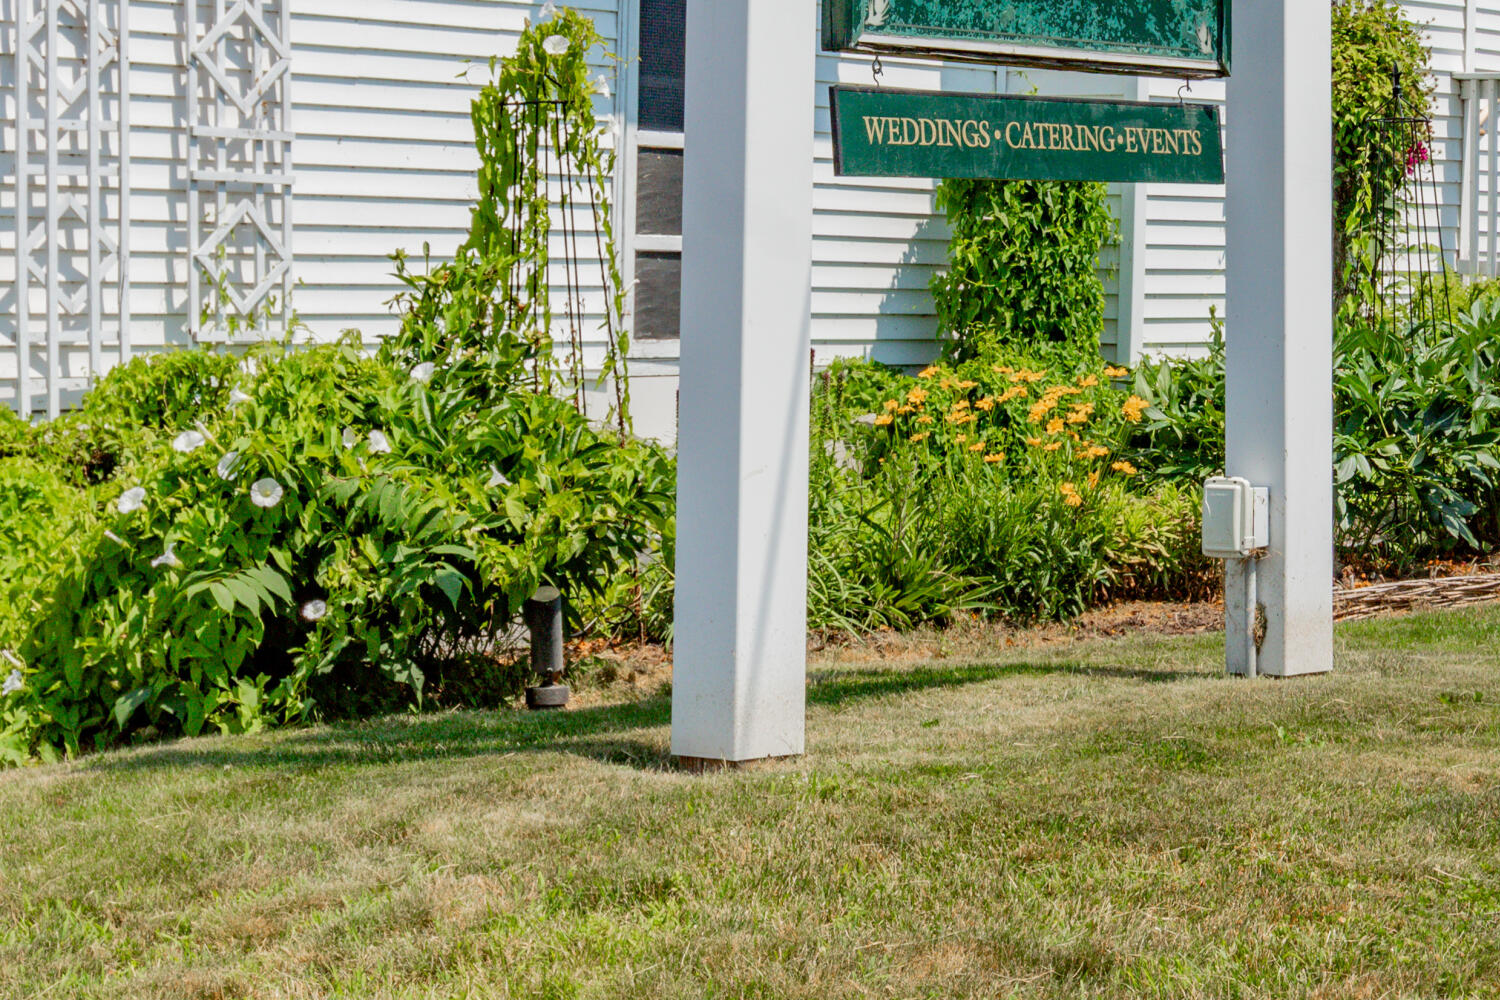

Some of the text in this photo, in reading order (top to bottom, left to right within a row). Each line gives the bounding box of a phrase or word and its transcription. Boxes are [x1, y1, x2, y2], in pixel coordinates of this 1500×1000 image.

[863, 116, 1203, 156] WEDDINGS CATERING EVENTS
